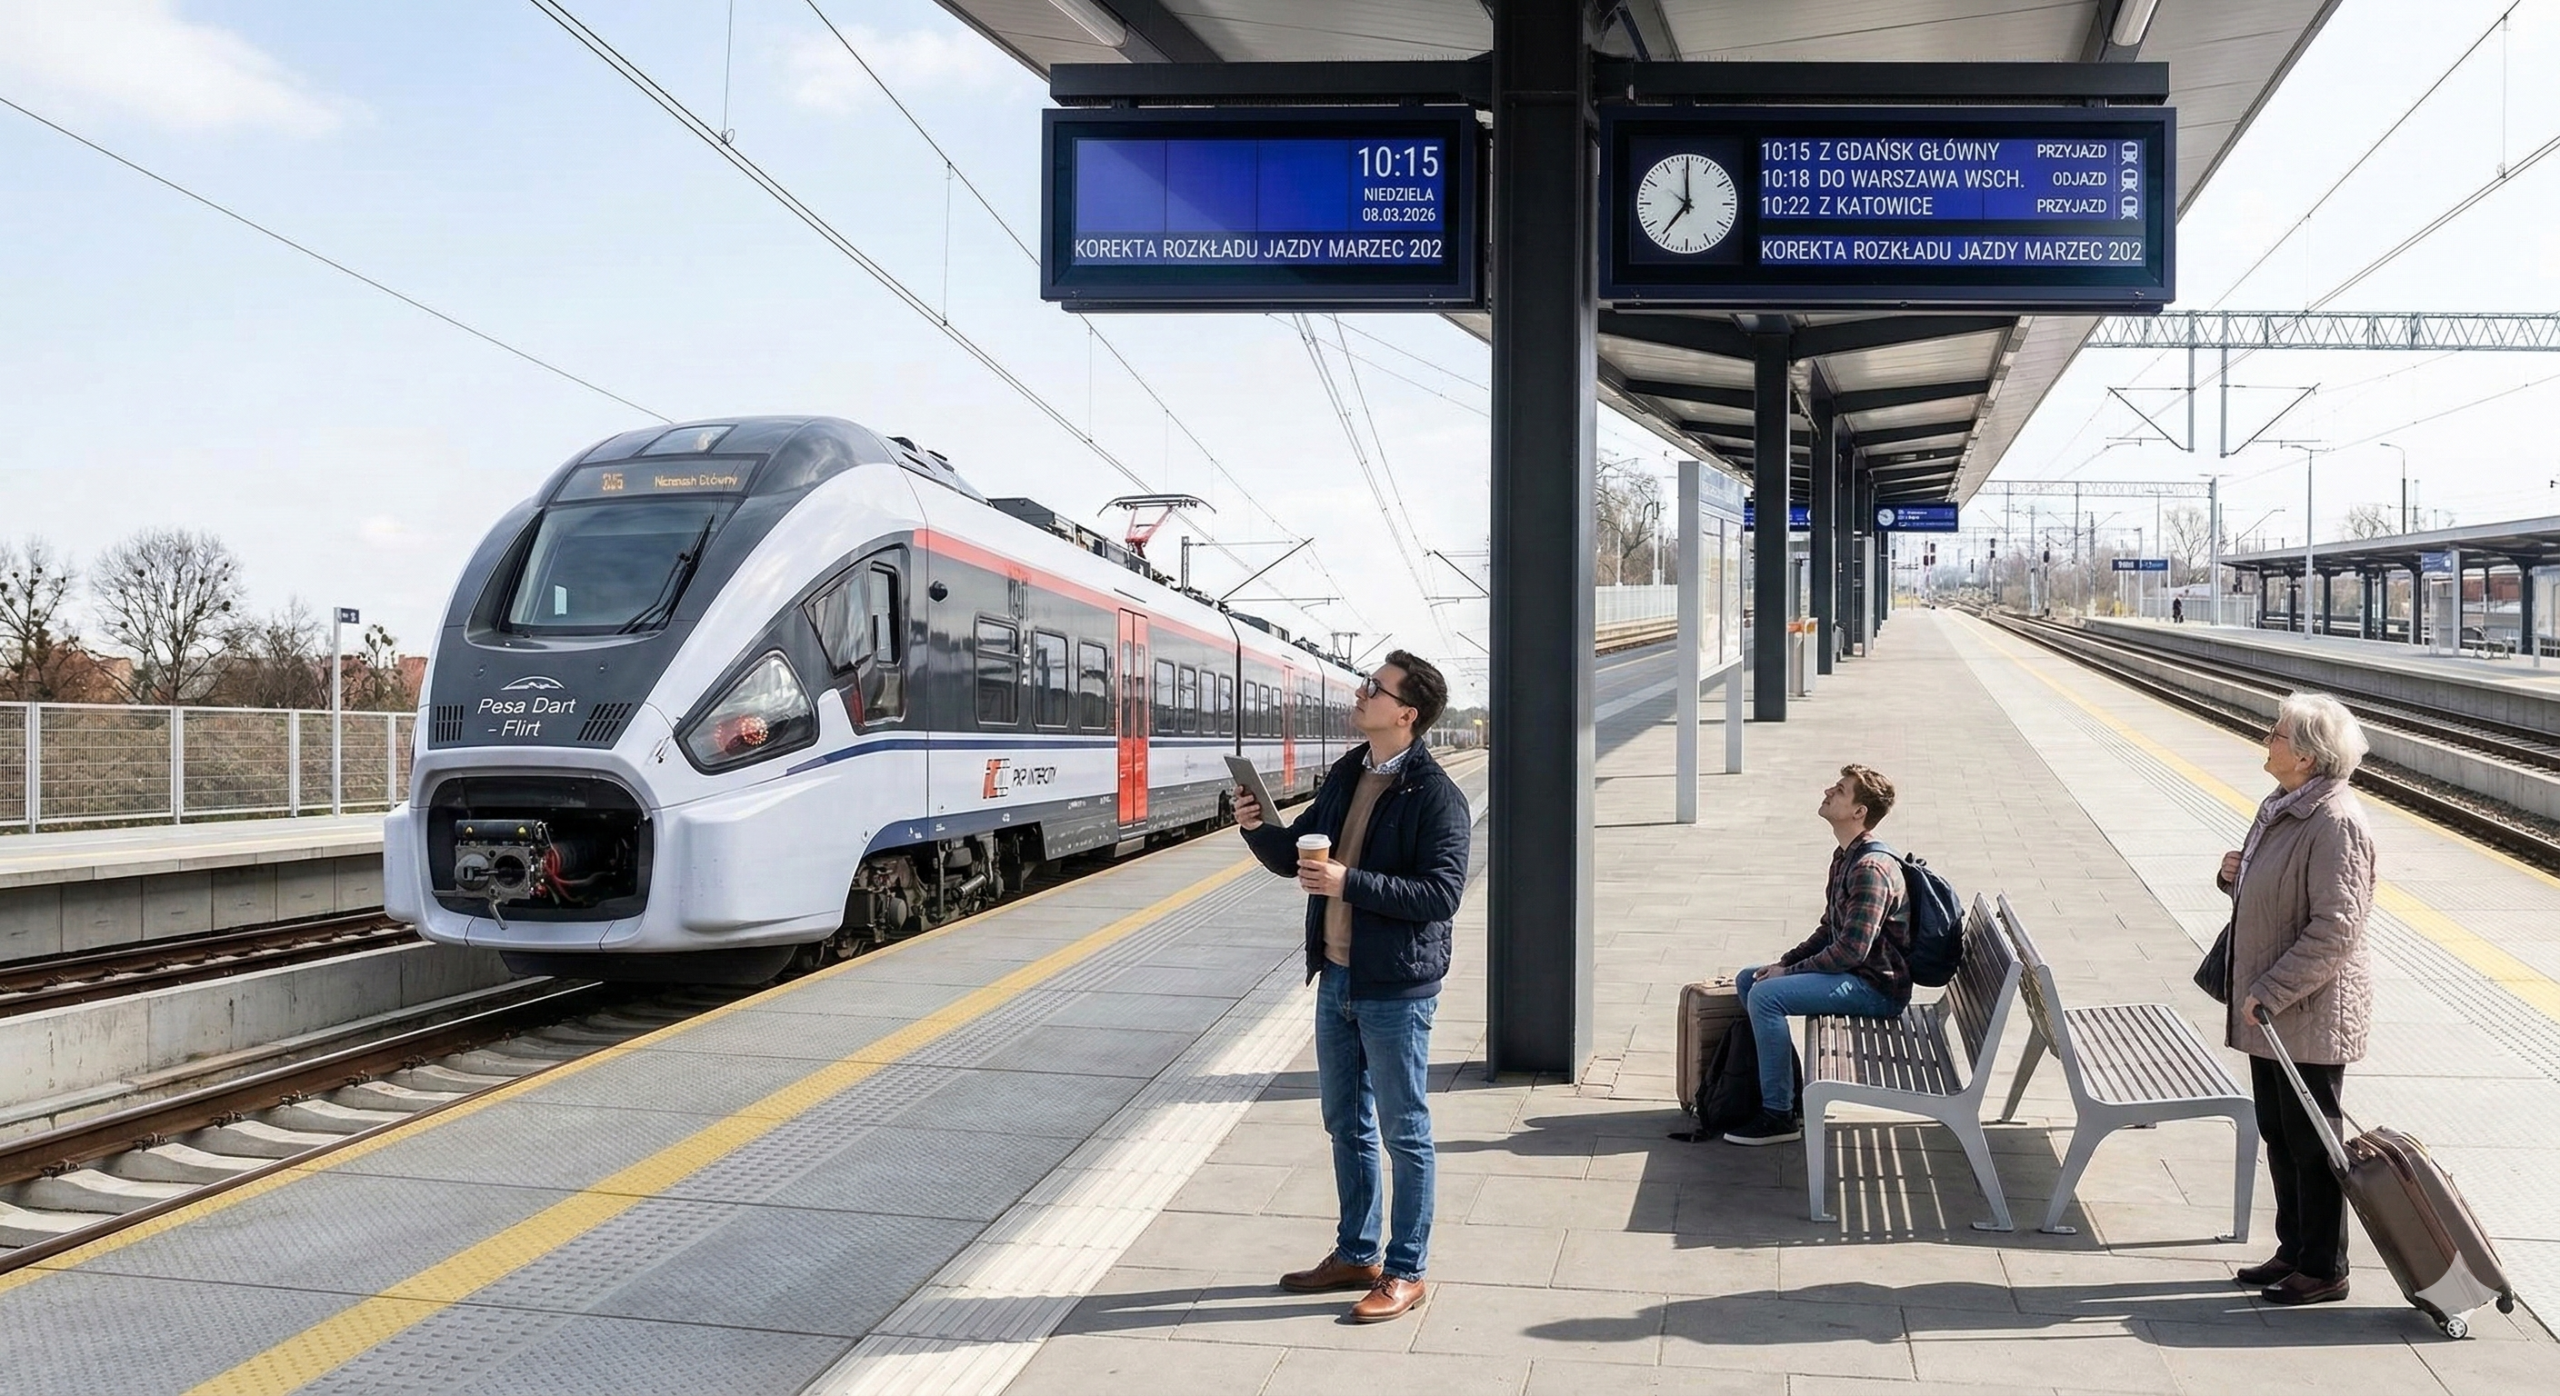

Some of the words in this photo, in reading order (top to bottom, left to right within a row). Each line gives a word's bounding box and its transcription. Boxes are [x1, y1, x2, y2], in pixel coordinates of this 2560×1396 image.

[1762, 142, 1810, 161] 10:15
[1819, 142, 1831, 161] Z
[1836, 138, 1914, 161] GDAŃSK
[1919, 138, 2000, 161] GŁÓWNY
[2037, 144, 2107, 159] PRZYJAZD
[1358, 146, 1438, 177] 10:15
[1762, 169, 1810, 188] 10:18
[1819, 169, 1845, 188] DO
[1850, 169, 1959, 188] WARSZAWA
[1964, 169, 2025, 188] WSCH.
[2052, 171, 2107, 186] ODJAZD
[1364, 187, 1435, 202] NIEDZIELA
[1362, 207, 1436, 222] 08.03.2026
[1762, 196, 1810, 215] 10:22
[1819, 196, 1831, 215] Z
[1837, 196, 1933, 216] KATOWICE
[2037, 198, 2107, 214] PRZYJAZD
[1075, 239, 1158, 258] KOREKTA
[1163, 239, 1258, 259] ROZKŁADU
[1263, 239, 1323, 258] JAZDY
[1329, 239, 1404, 258] MARZEC
[1409, 238, 1442, 258] 202
[1762, 240, 1847, 260] KOREKTA
[1853, 240, 1951, 261] ROZKŁADU
[1958, 241, 2019, 261] JAZDY
[2025, 241, 2103, 261] MARZEC
[2108, 241, 2143, 261] 202
[477, 698, 526, 714] Pesa
[532, 697, 576, 714] Dart
[501, 720, 541, 737] Flirt
